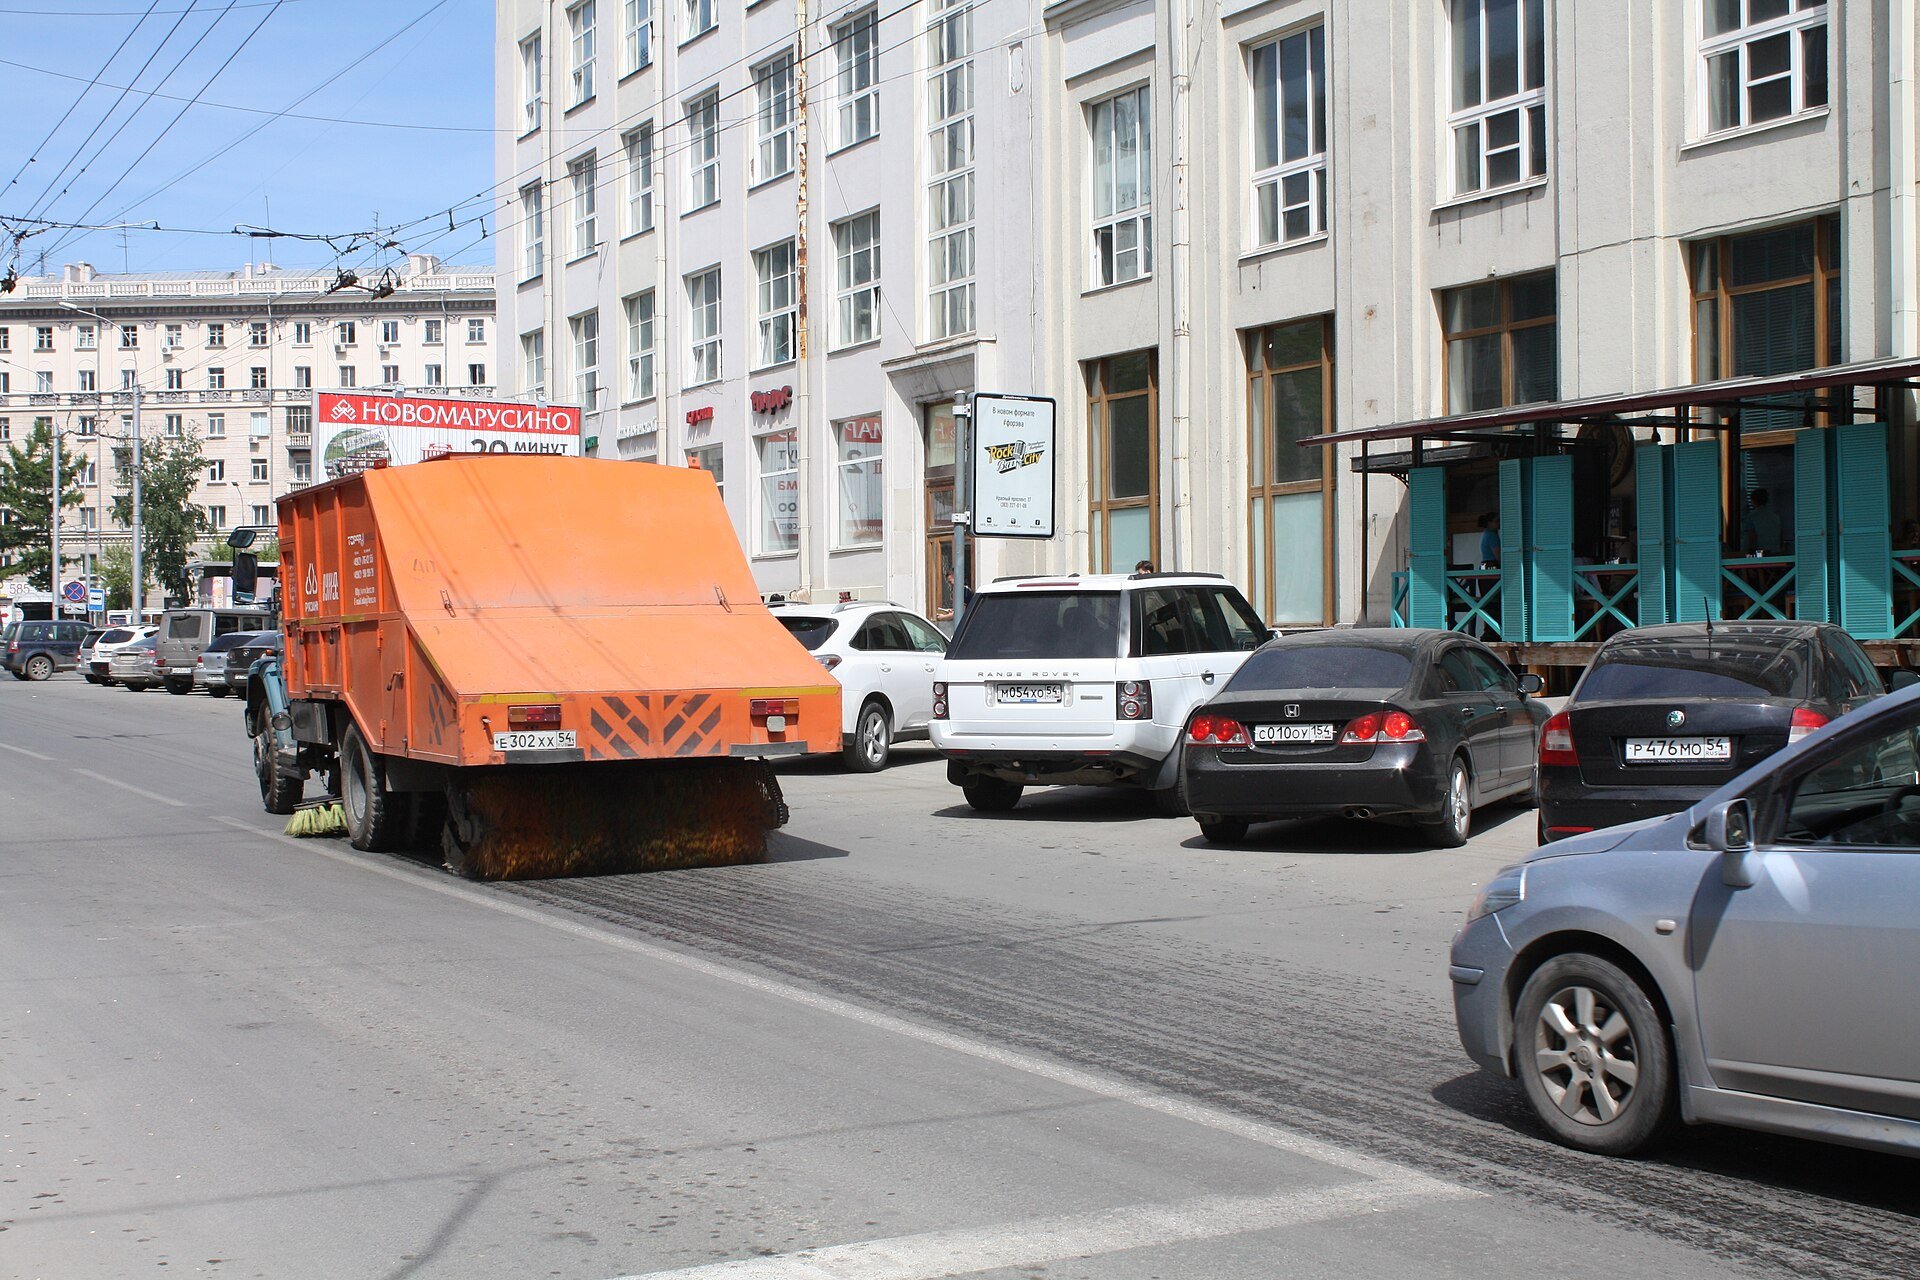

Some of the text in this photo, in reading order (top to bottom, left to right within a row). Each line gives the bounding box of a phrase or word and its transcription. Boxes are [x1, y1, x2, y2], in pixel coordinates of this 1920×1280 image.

[362, 401, 571, 431] НОВОМАРУСИНО
[1014, 409, 1035, 417] формате
[989, 445, 1013, 463] Rock
[9, 583, 30, 595] 585
[1311, 725, 1330, 735] 154
[558, 732, 571, 743] 54
[1706, 738, 1723, 751] 54
